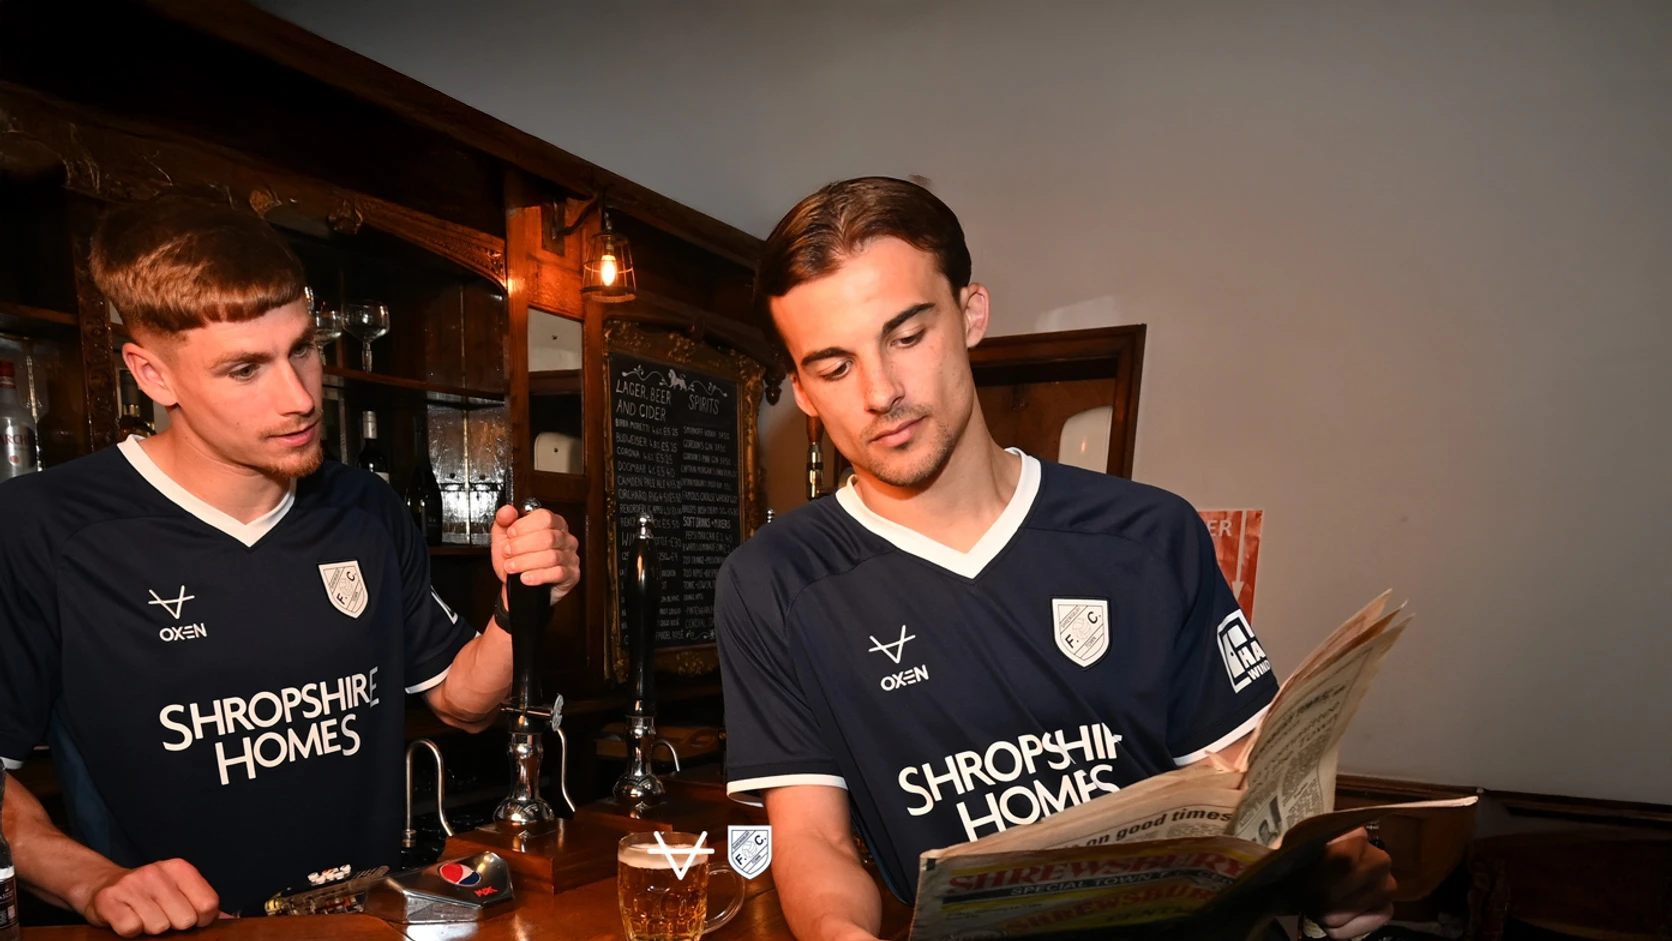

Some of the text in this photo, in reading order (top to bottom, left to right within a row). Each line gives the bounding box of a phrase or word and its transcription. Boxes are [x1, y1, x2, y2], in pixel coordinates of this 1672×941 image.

[650, 387, 672, 405] BEER
[688, 394, 720, 415] SPIRITS
[616, 399, 667, 421] AND CIDER
[616, 432, 648, 447] BUDWEISER
[617, 446, 641, 459] CORONA
[617, 475, 643, 487] CAMDEN
[618, 488, 648, 501] ORCHARD
[683, 516, 695, 528] SOFT
[696, 517, 711, 528] DRINKS
[159, 622, 208, 641] OXEN
[880, 664, 929, 691] OXEN
[159, 666, 379, 751] SHROPSHIRE
[215, 713, 361, 785] HOMES
[1086, 833, 1110, 847] on
[1116, 813, 1168, 842] good
[1172, 807, 1233, 829] times
[1010, 880, 1087, 896] SPECIAL
[1095, 873, 1153, 887] TOWN
